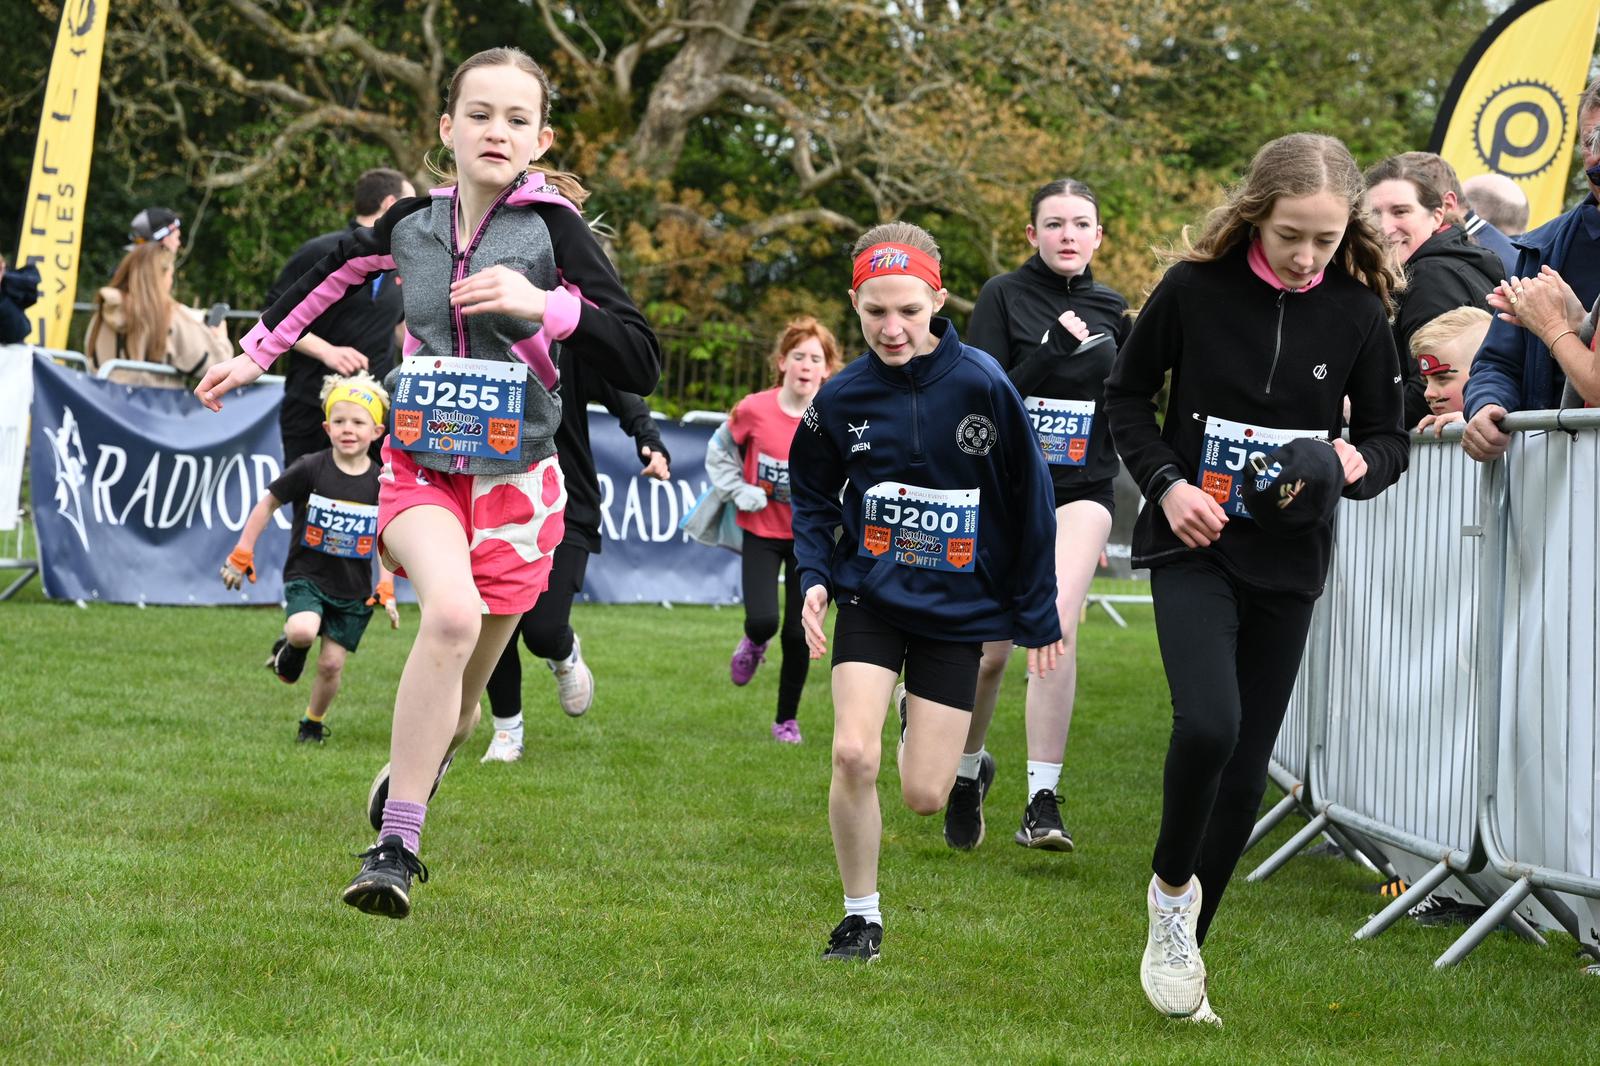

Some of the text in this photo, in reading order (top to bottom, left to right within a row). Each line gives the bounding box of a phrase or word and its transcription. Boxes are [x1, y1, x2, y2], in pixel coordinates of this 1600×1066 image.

[415, 380, 500, 412] J255
[507, 386, 516, 413] STORM
[432, 408, 479, 423] Radnor
[428, 435, 478, 453] FLOWFIT
[1205, 440, 1213, 465] JUNIOR
[1211, 441, 1220, 467] STORM
[870, 499, 878, 521] STORM
[882, 503, 959, 533] J200
[319, 512, 366, 534] J274
[895, 551, 937, 567] FLOWFIT
